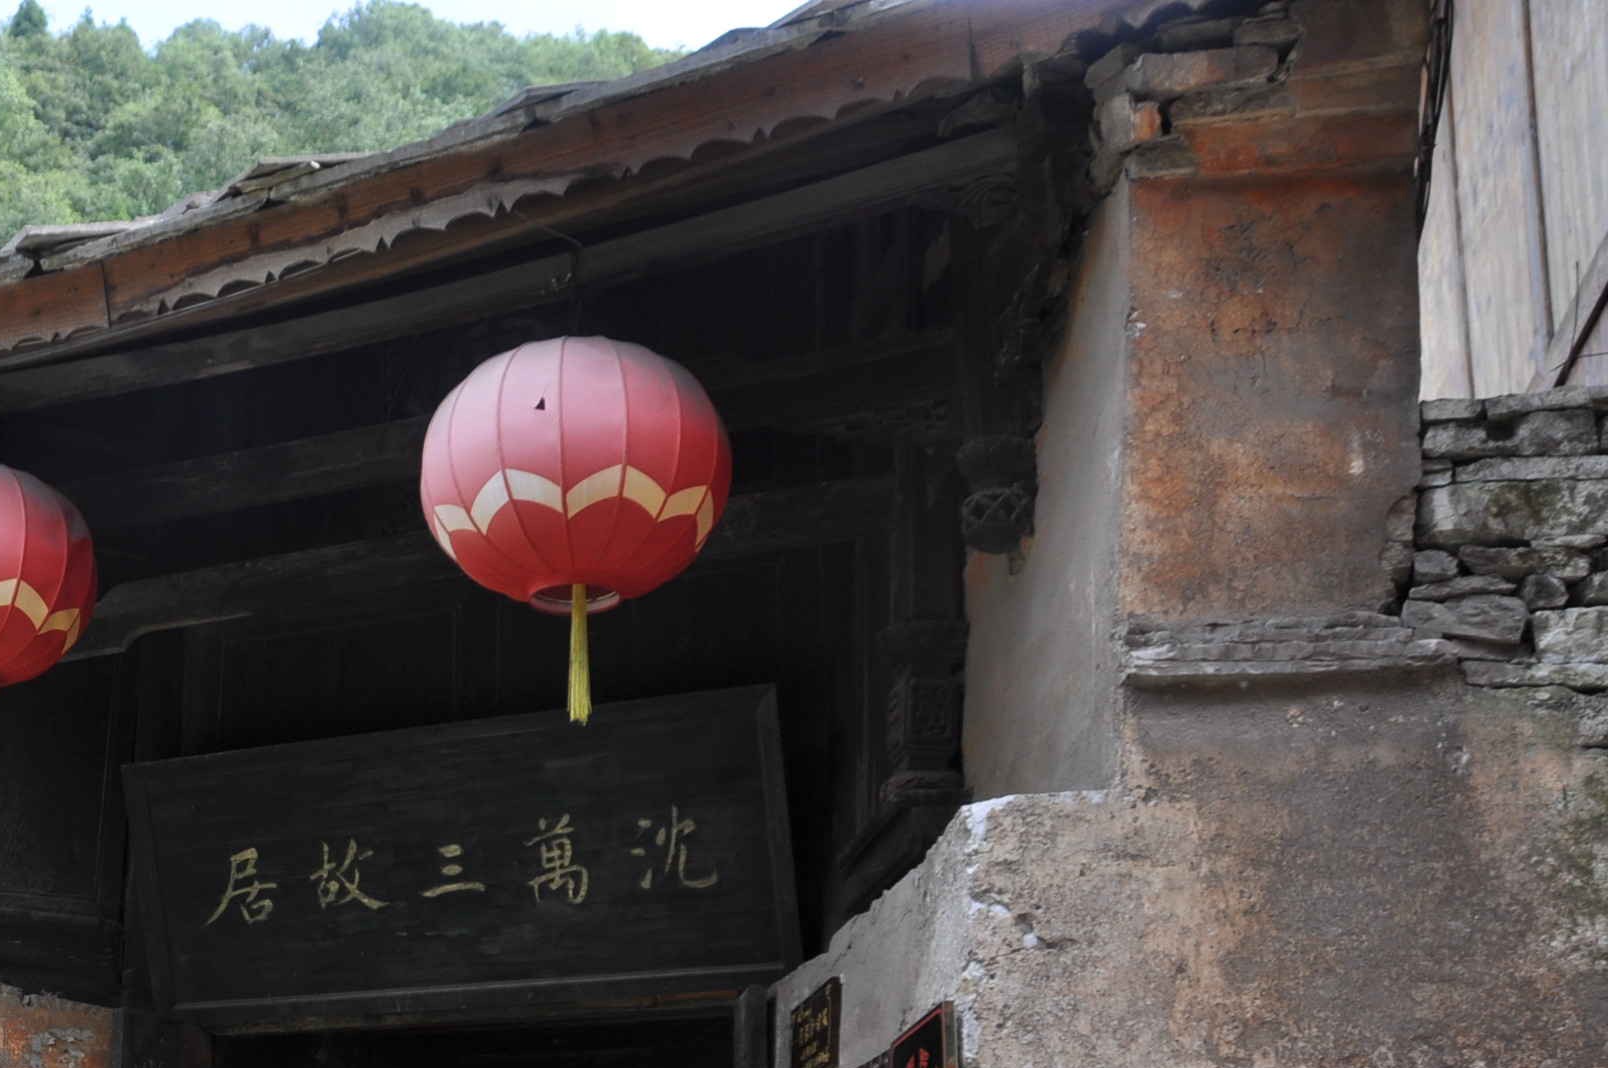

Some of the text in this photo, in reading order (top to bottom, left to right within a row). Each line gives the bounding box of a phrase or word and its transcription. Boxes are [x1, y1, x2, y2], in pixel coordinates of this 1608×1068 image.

[204, 805, 718, 927] 沈萬三故居
